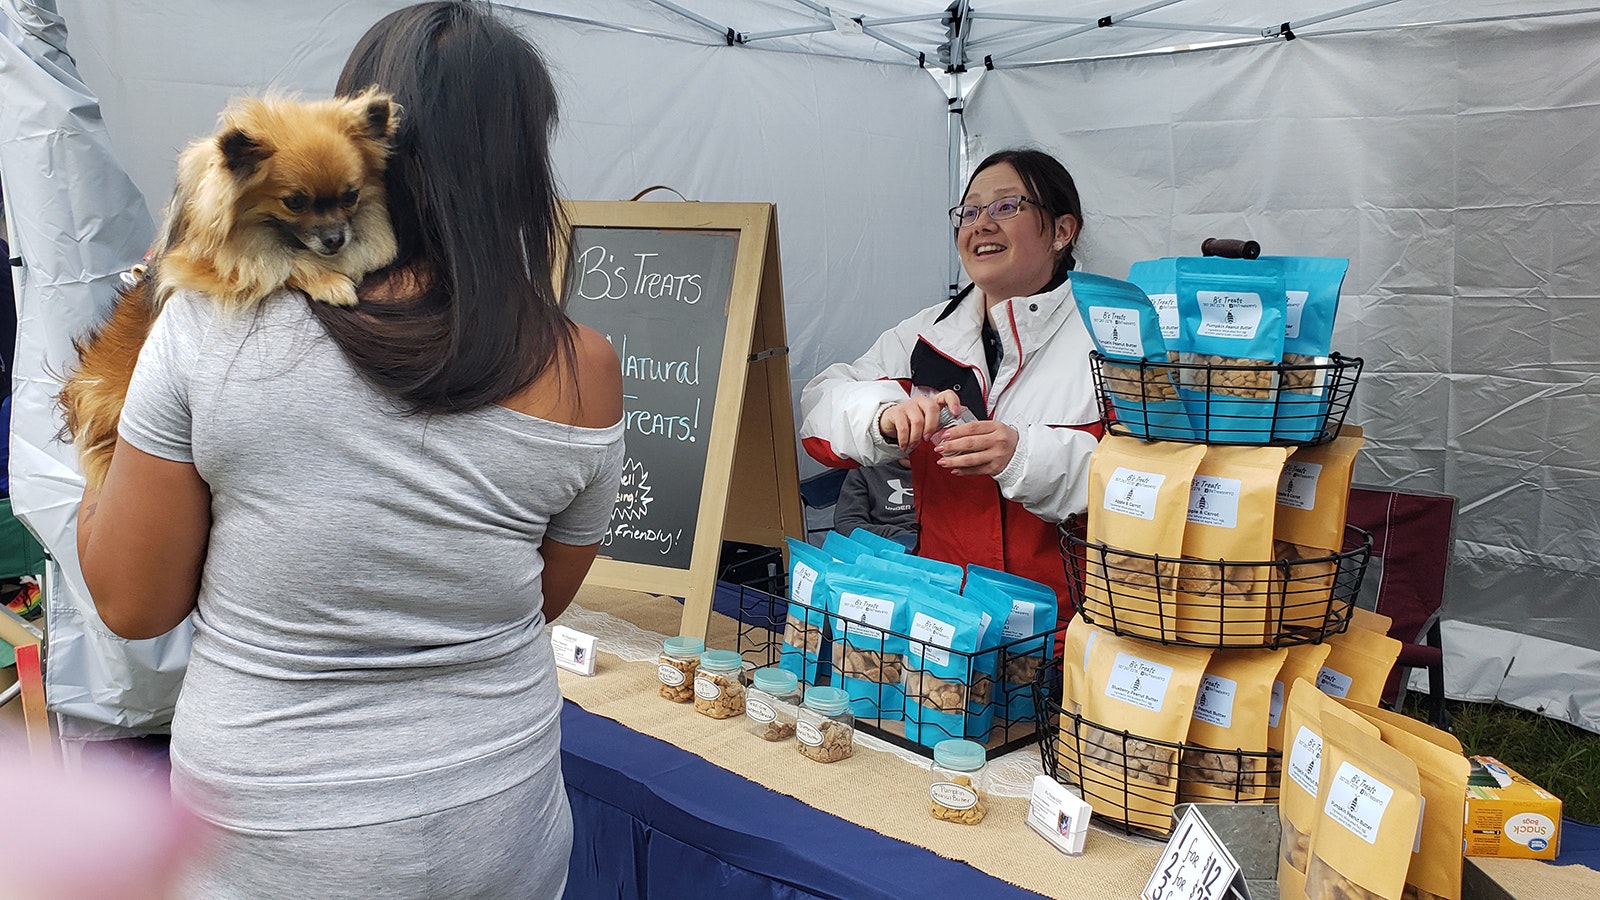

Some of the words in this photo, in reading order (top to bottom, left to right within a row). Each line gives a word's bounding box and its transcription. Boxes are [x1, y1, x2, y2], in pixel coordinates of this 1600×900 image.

[578, 246, 629, 301] B's
[1513, 825, 1547, 835] Snack
[1522, 818, 1539, 826] Bags
[1164, 851, 1179, 879] 2
